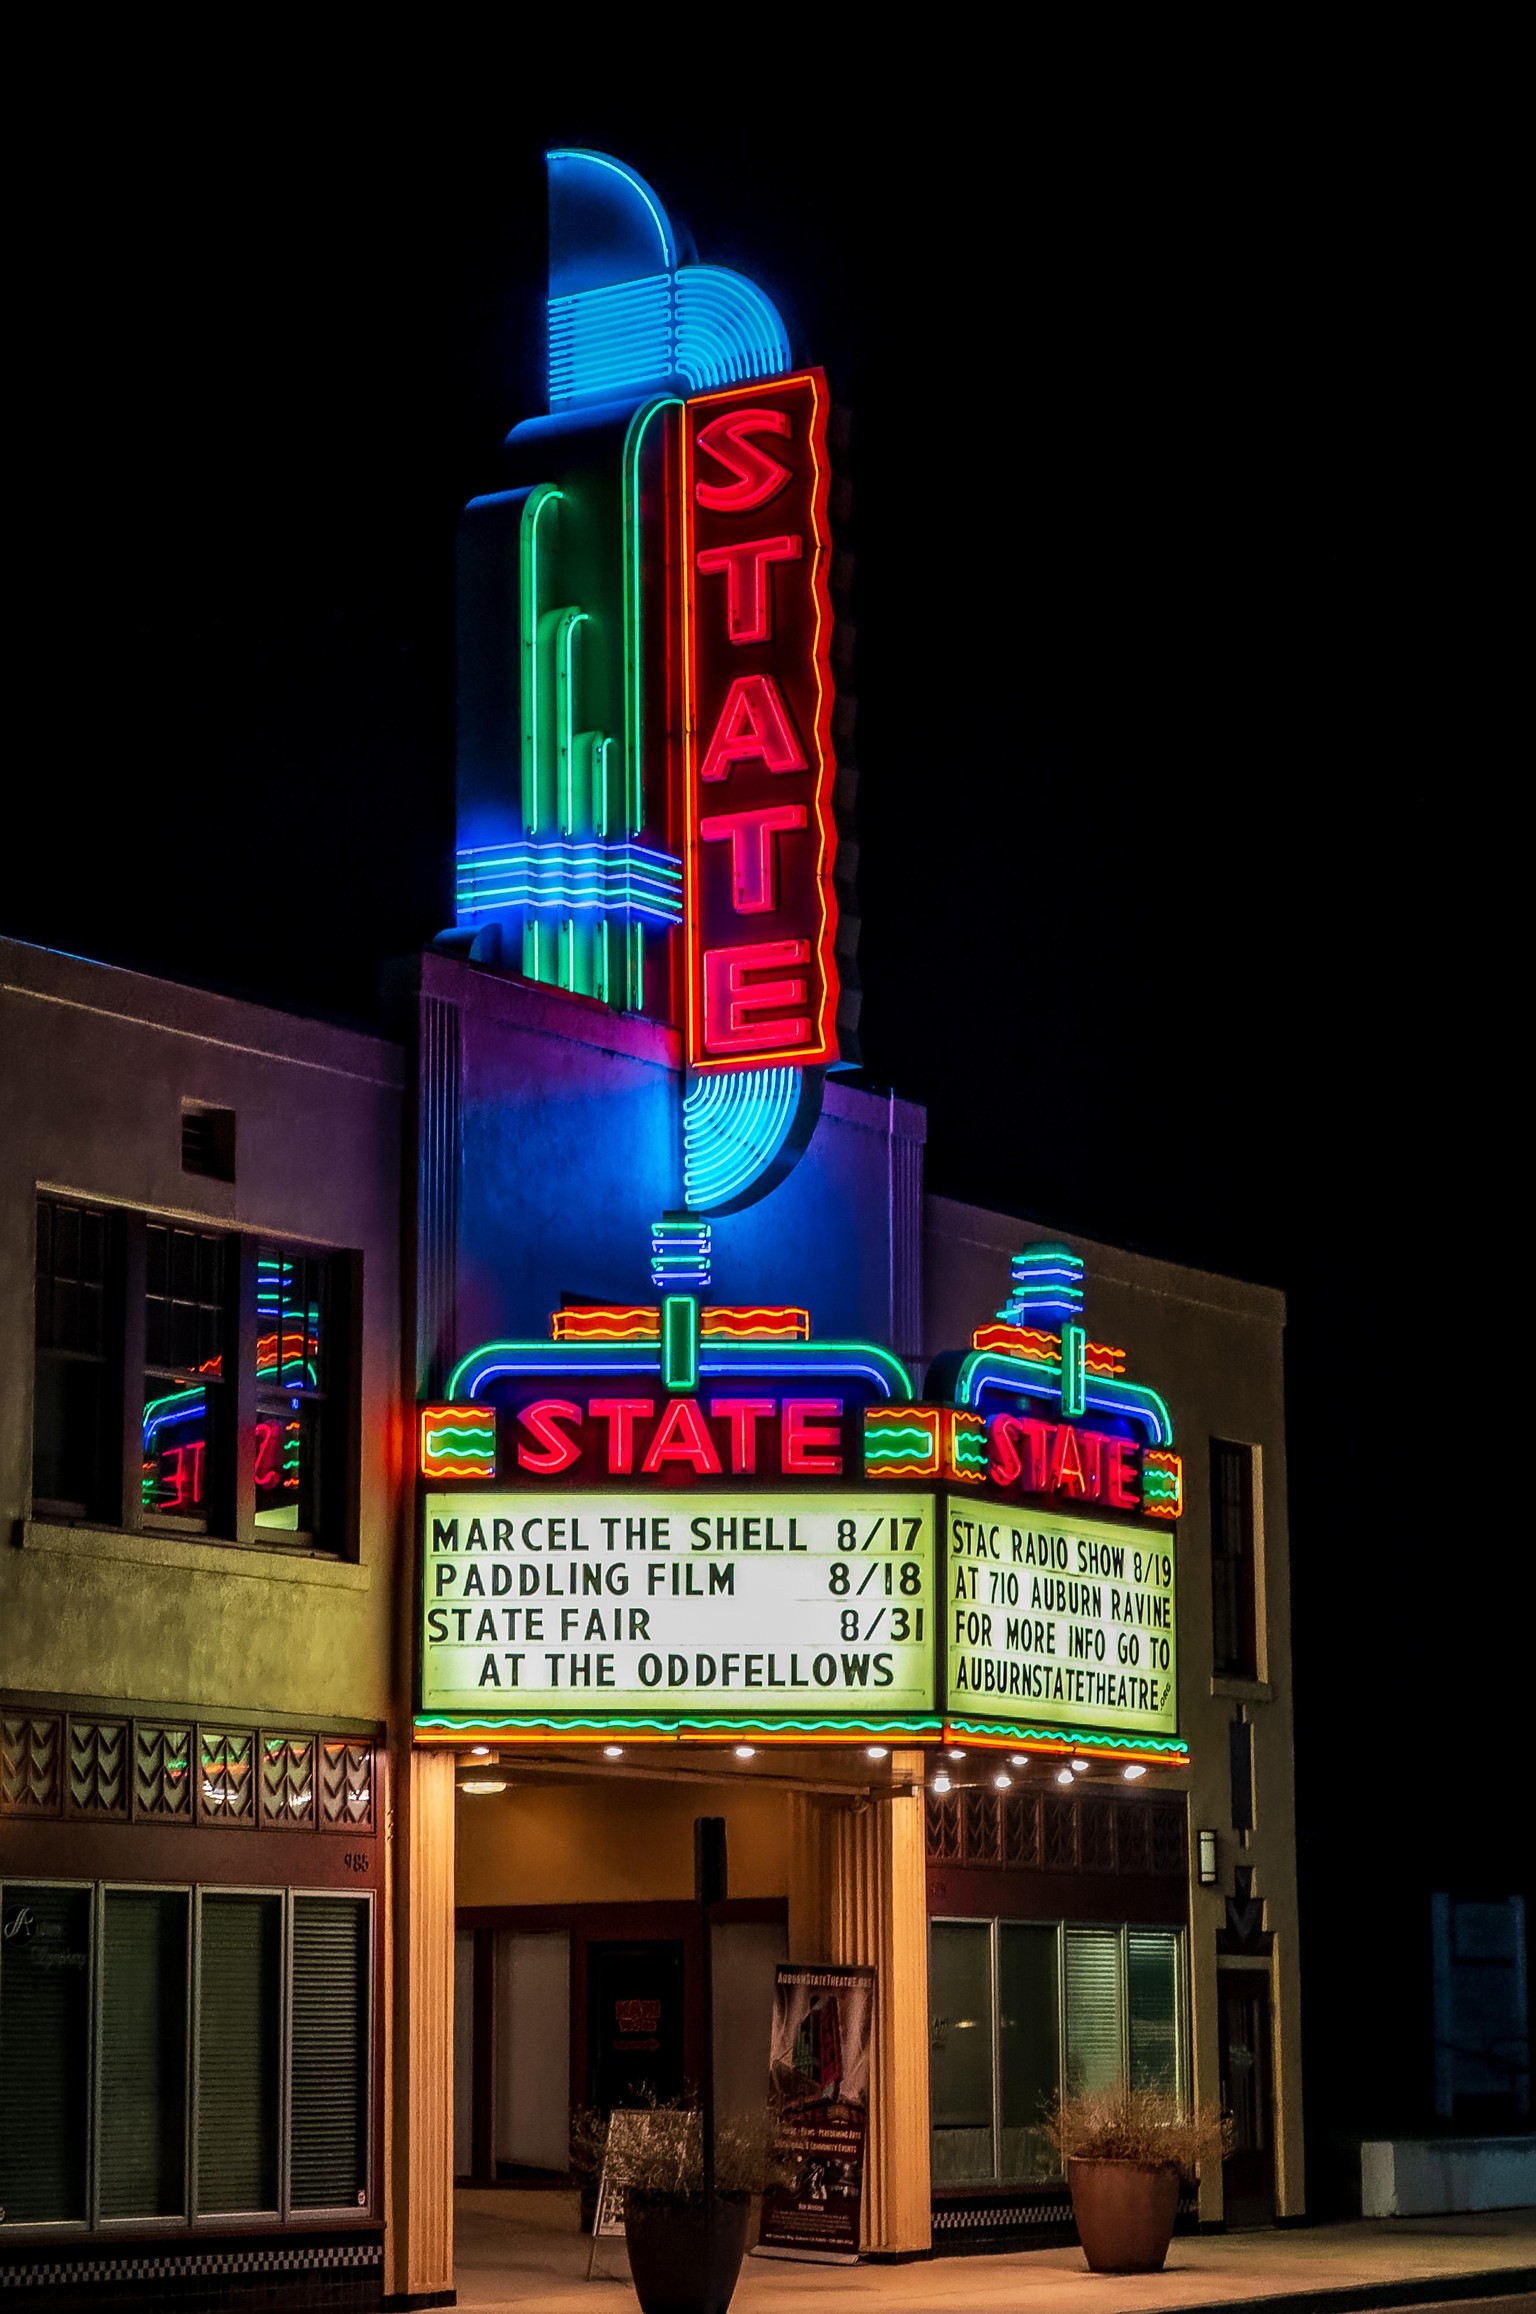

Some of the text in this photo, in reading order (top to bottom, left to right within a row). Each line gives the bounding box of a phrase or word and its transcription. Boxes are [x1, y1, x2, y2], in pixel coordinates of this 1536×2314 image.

[696, 408, 812, 1054] STATE
[517, 1398, 843, 1475] STATE
[990, 1412, 1140, 1510] STATE
[433, 1517, 924, 1552] MARCEL THE SHELL 8/17
[953, 1519, 1171, 1588] STAC RADIO SHOW 8/19
[436, 1562, 922, 1597] PADDLING FILM 8/18
[955, 1565, 1171, 1629] AT 710 AUBURN RAVINE
[427, 1607, 924, 1642] STATE FAIR 8/31
[955, 1610, 1170, 1671] FOR MORE INFO GO TO
[478, 1653, 895, 1688] AT THE ODDFELLOWS
